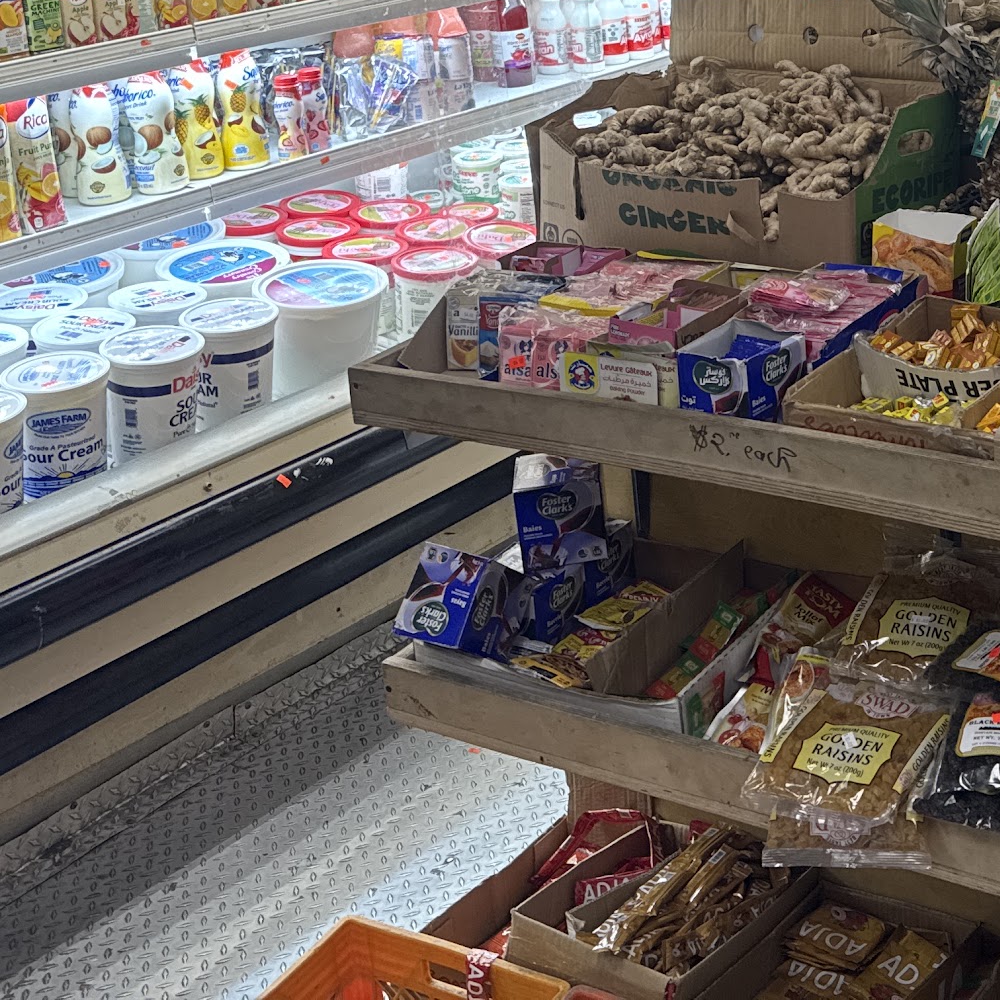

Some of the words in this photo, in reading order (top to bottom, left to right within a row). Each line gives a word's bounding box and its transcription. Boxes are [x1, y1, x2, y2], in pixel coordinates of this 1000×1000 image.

[30, 1, 60, 12] GREEN
[72, 5, 90, 15] Apple
[18, 147, 37, 158] Fruit
[600, 362, 623, 373] Levure
[625, 365, 653, 378] Gâteaux
[765, 354, 788, 372] Foster
[765, 365, 789, 383] Clark's
[895, 368, 960, 397] PLATE
[31, 415, 61, 430] JAMES
[61, 411, 88, 425] FARM
[29, 444, 50, 453] Grade
[57, 434, 96, 451] Pasteurized
[58, 438, 104, 462] Cream
[744, 445, 798, 474] each
[541, 493, 574, 509] Foster
[541, 503, 575, 515] Clark's
[522, 524, 543, 535] Baies
[811, 584, 844, 611] TASTY
[795, 603, 825, 625] Jollof
[900, 601, 930, 611] PREMIUM
[930, 604, 961, 616] QUALITY
[415, 615, 442, 634] Foster
[793, 611, 816, 627] Mix
[895, 608, 957, 630] GOLDEN
[888, 638, 900, 646] Net
[890, 622, 952, 644] RAISINS
[861, 692, 912, 715] SWAD
[970, 718, 994, 727] BLACK
[860, 728, 890, 740] QUALITY
[912, 743, 934, 772] GOLDEN
[931, 718, 950, 747] RAISINS
[812, 743, 874, 766] RAISINS
